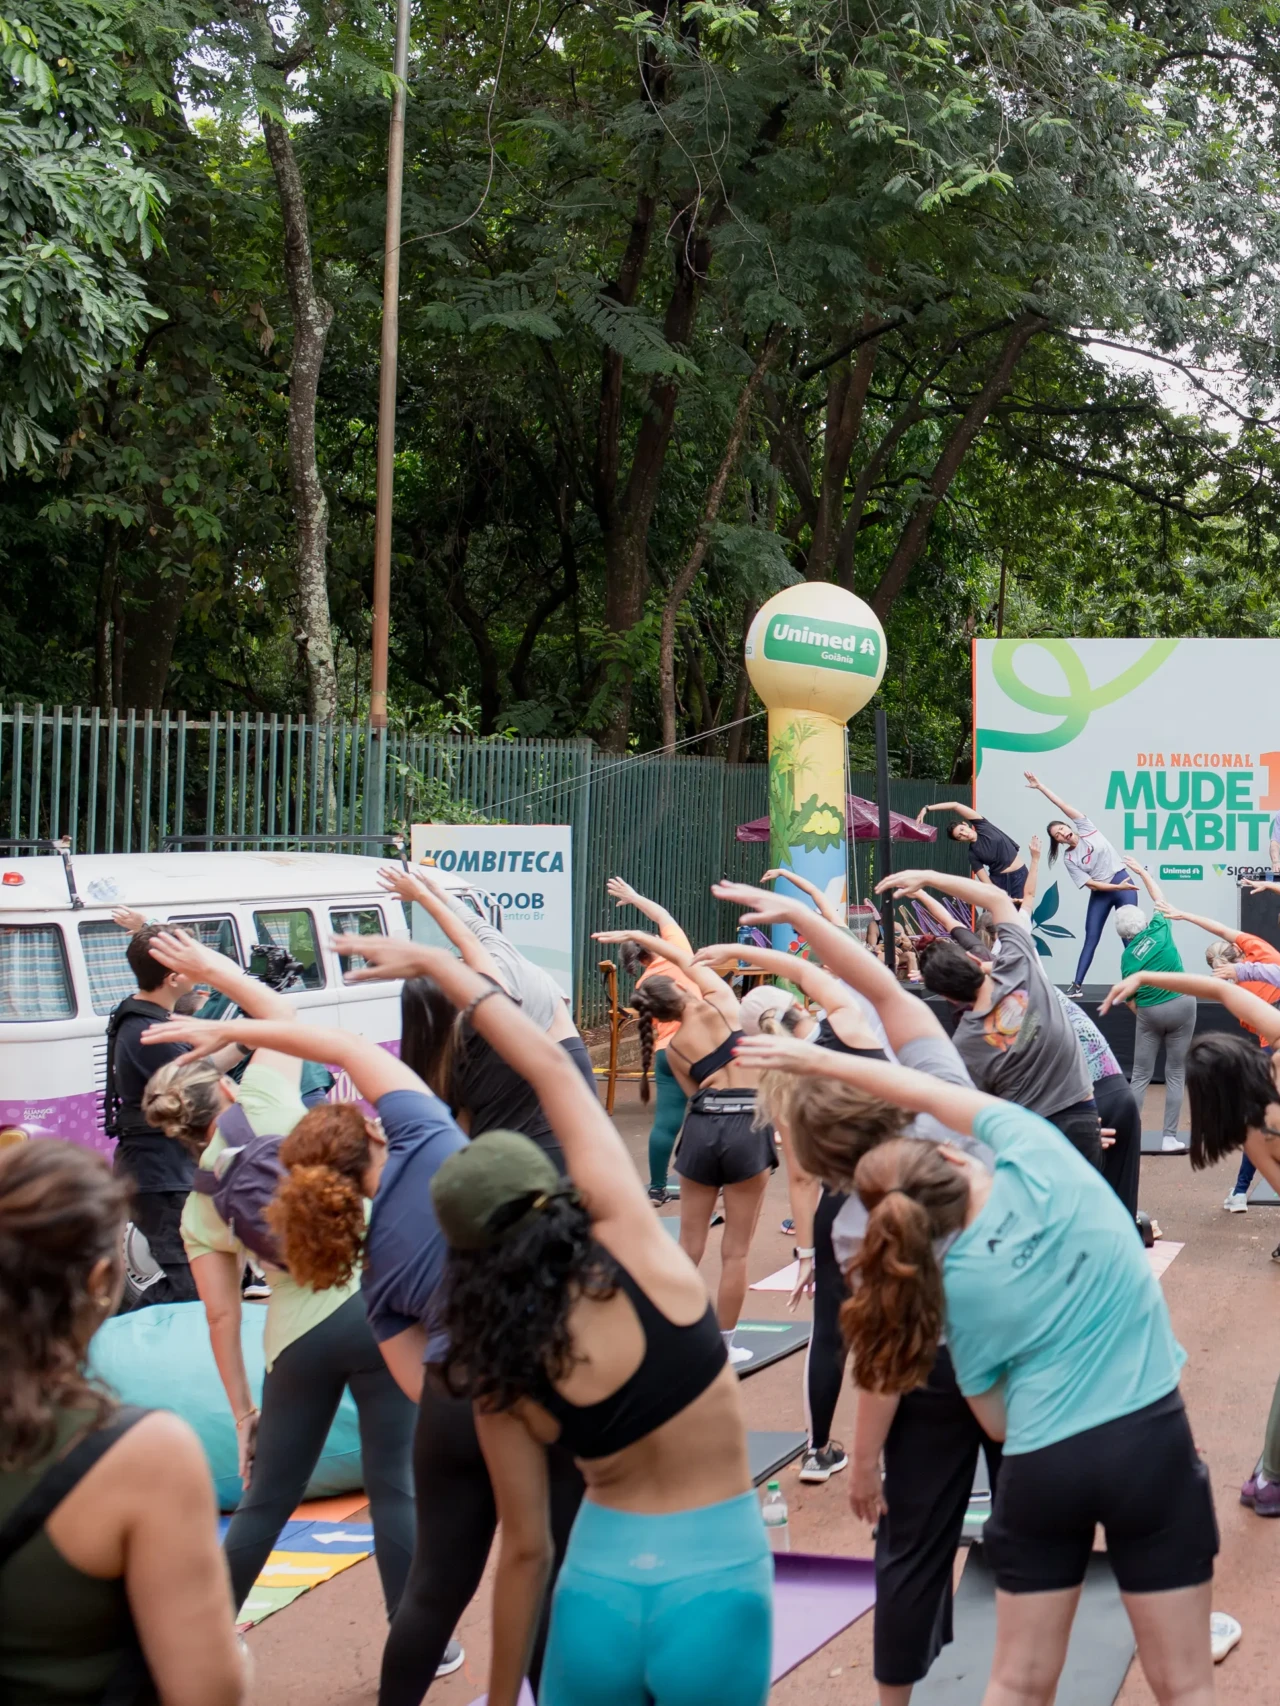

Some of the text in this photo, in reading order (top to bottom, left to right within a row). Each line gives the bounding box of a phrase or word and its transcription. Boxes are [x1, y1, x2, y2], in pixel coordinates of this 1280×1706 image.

[773, 624, 856, 652] Unimed
[821, 651, 854, 664] Goiânia
[1137, 753, 1254, 767] DIA NACIONAL
[1105, 771, 1254, 811] MUDE
